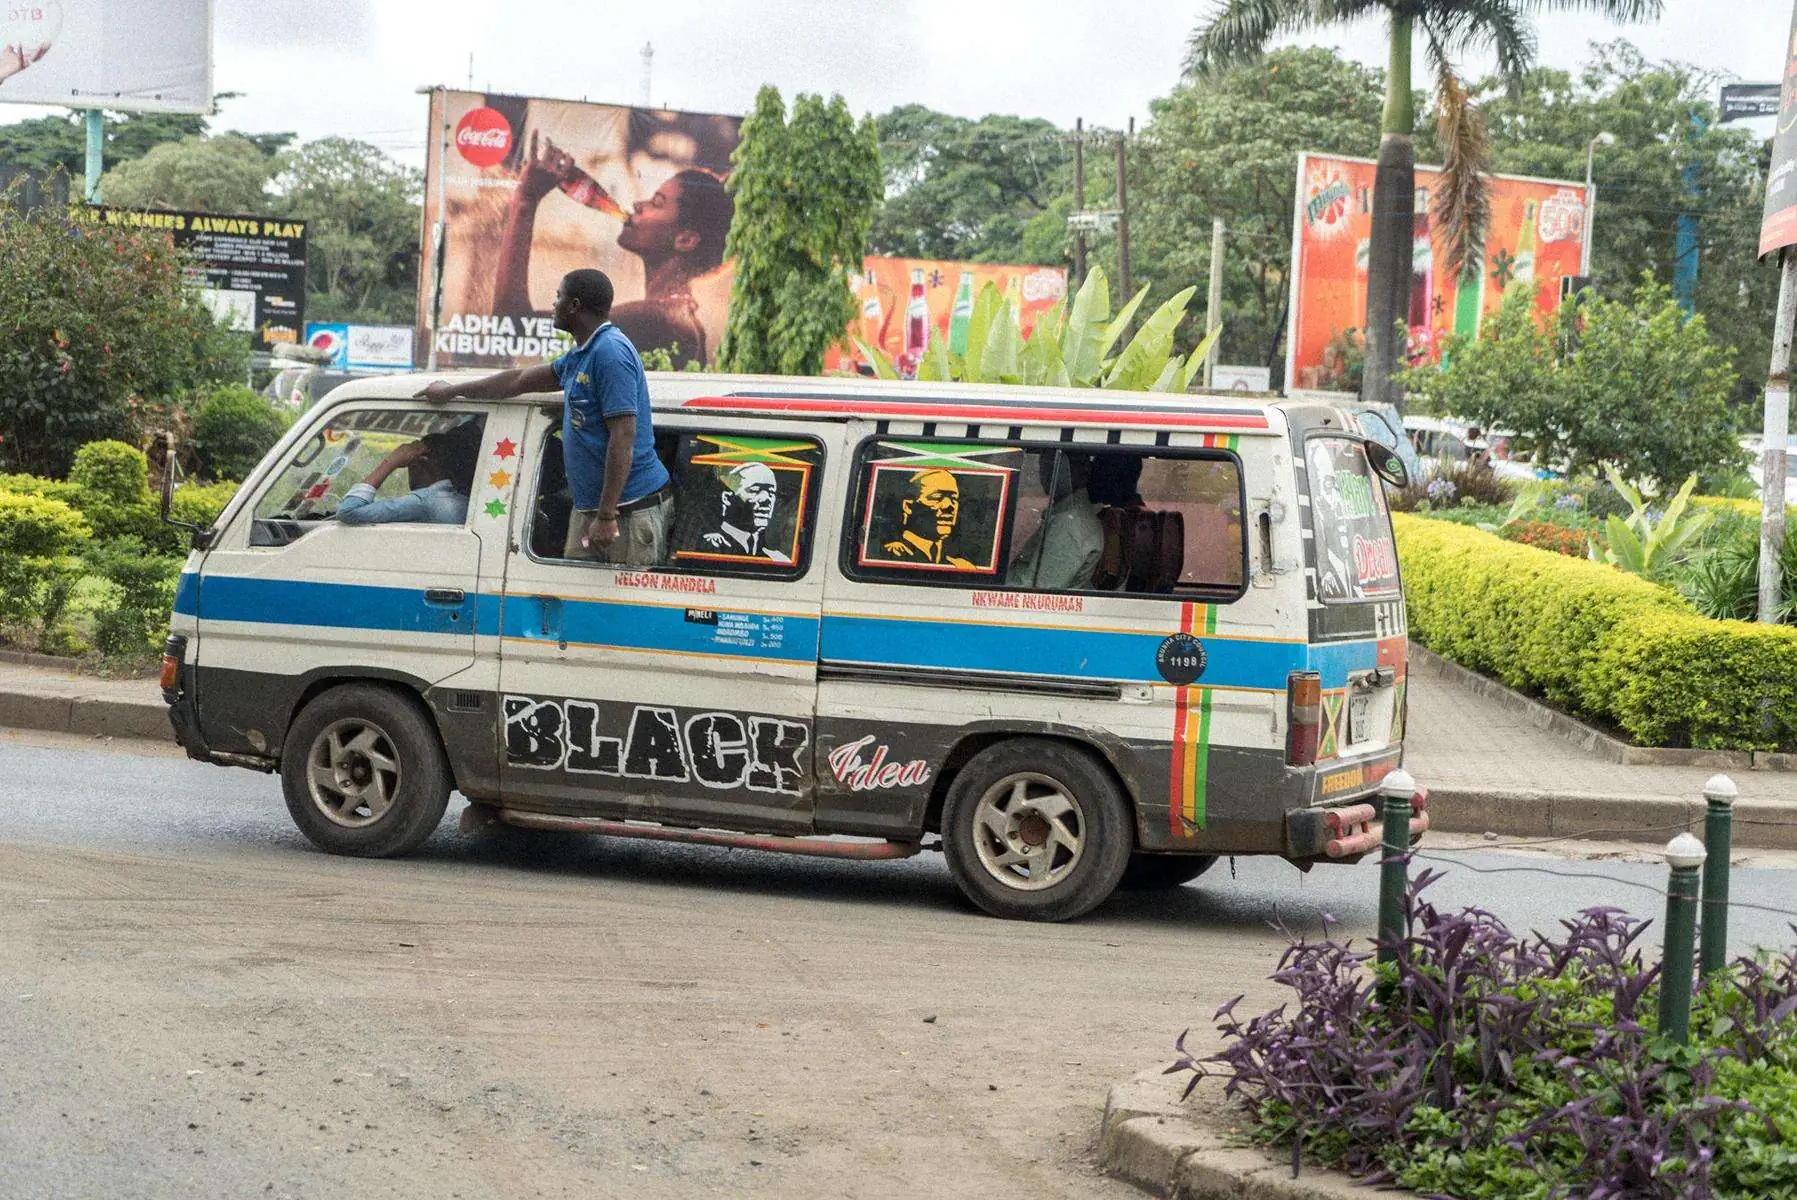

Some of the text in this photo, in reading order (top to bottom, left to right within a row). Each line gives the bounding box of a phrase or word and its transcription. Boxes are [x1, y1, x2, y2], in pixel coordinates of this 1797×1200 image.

[190, 216, 258, 235] ALWAYS
[263, 220, 304, 238] PLAY
[615, 572, 716, 594] NELSON MANDELA
[1170, 656, 1197, 667] 1198
[503, 695, 810, 796] BLACK
[827, 734, 930, 792] Idea
